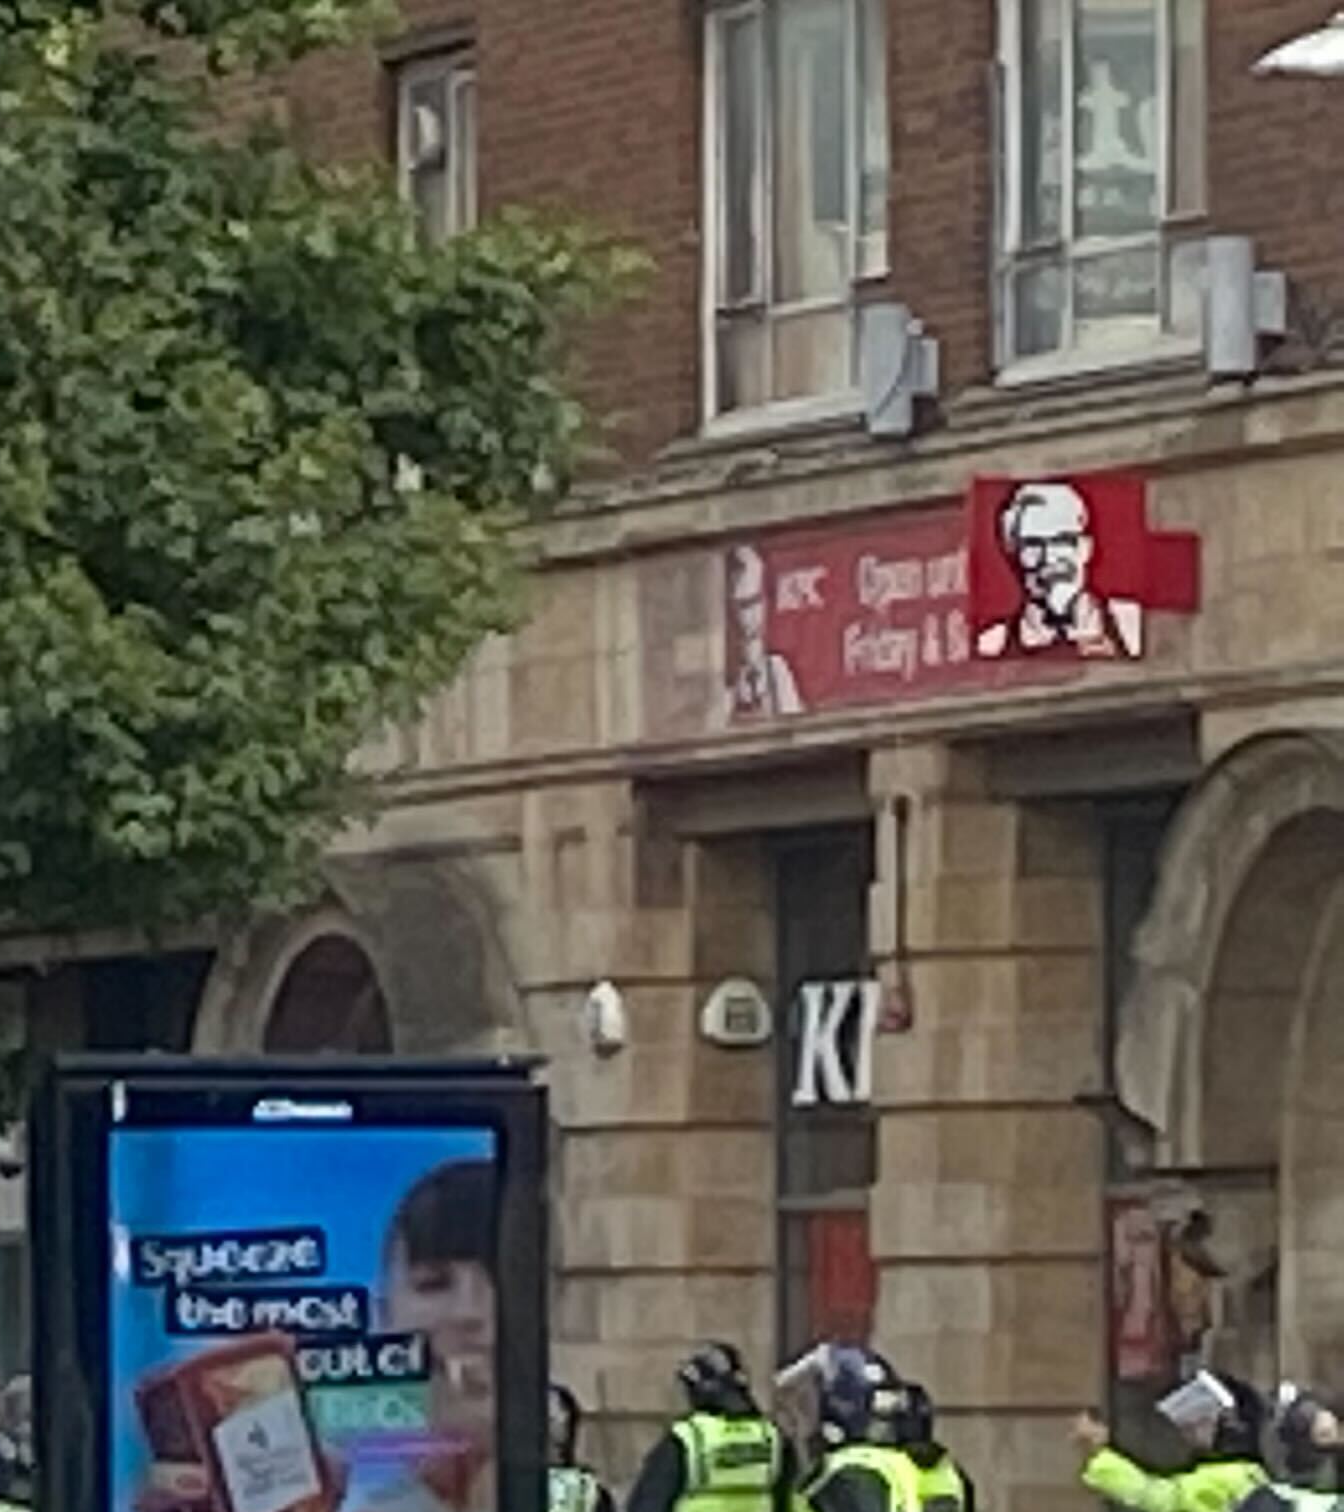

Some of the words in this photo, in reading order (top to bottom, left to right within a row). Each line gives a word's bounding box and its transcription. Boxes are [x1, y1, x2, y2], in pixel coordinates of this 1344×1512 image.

[139, 1237, 320, 1285] Squeeze
[176, 1290, 246, 1330] the
[252, 1293, 358, 1330] most
[298, 1344, 373, 1381] out
